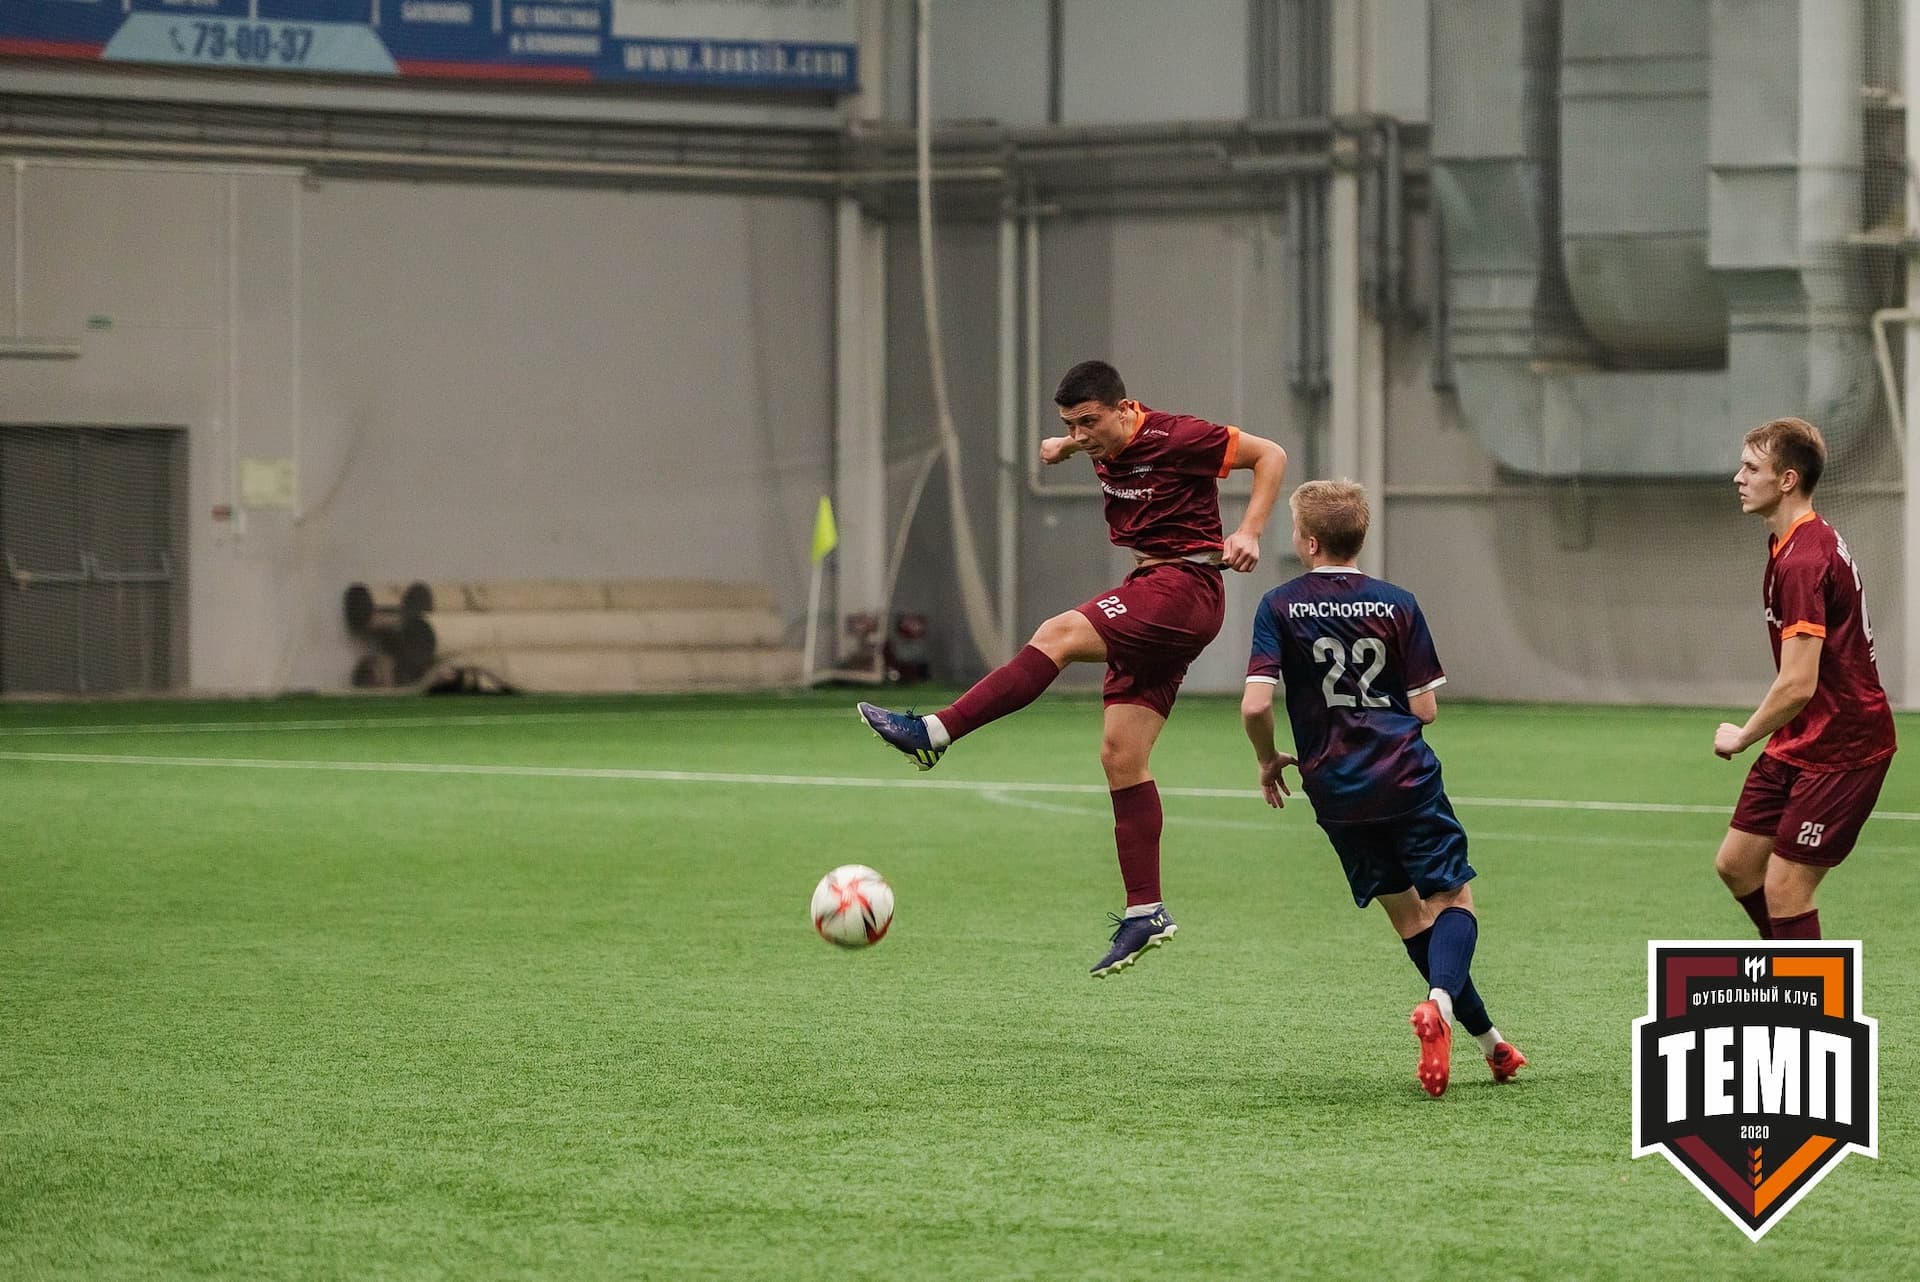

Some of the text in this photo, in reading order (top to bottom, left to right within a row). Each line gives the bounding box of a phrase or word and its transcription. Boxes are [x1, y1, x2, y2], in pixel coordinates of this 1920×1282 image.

[1097, 595, 1128, 619] 22
[1288, 601, 1396, 619] КРАСНОЯРСК
[1312, 636, 1392, 709] 22
[1797, 821, 1825, 847] 25
